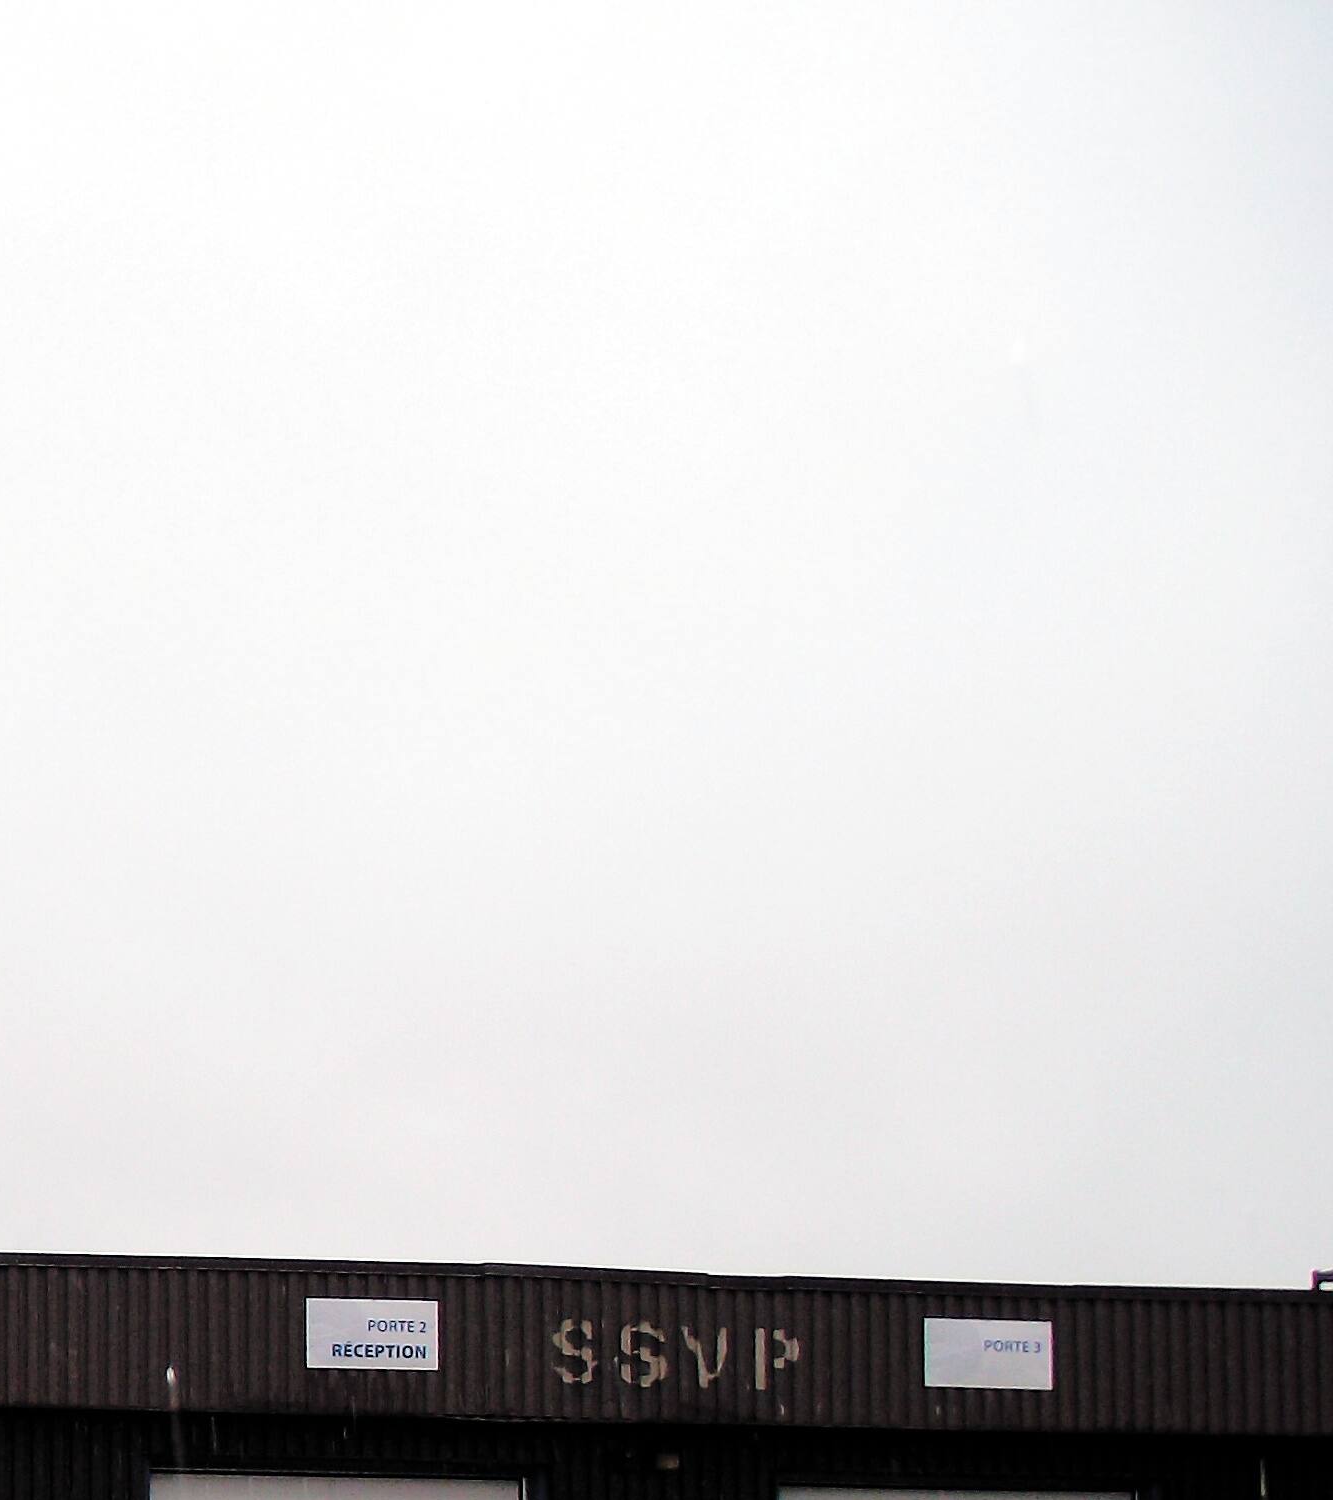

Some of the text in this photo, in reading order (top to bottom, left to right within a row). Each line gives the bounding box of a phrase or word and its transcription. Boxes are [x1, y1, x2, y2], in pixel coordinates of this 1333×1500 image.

[367, 1319, 426, 1333] PORTE 2
[332, 1341, 426, 1359] RÉCEPTION
[984, 1339, 1041, 1353] PORTE 3
[552, 1318, 800, 1391] SSVP
